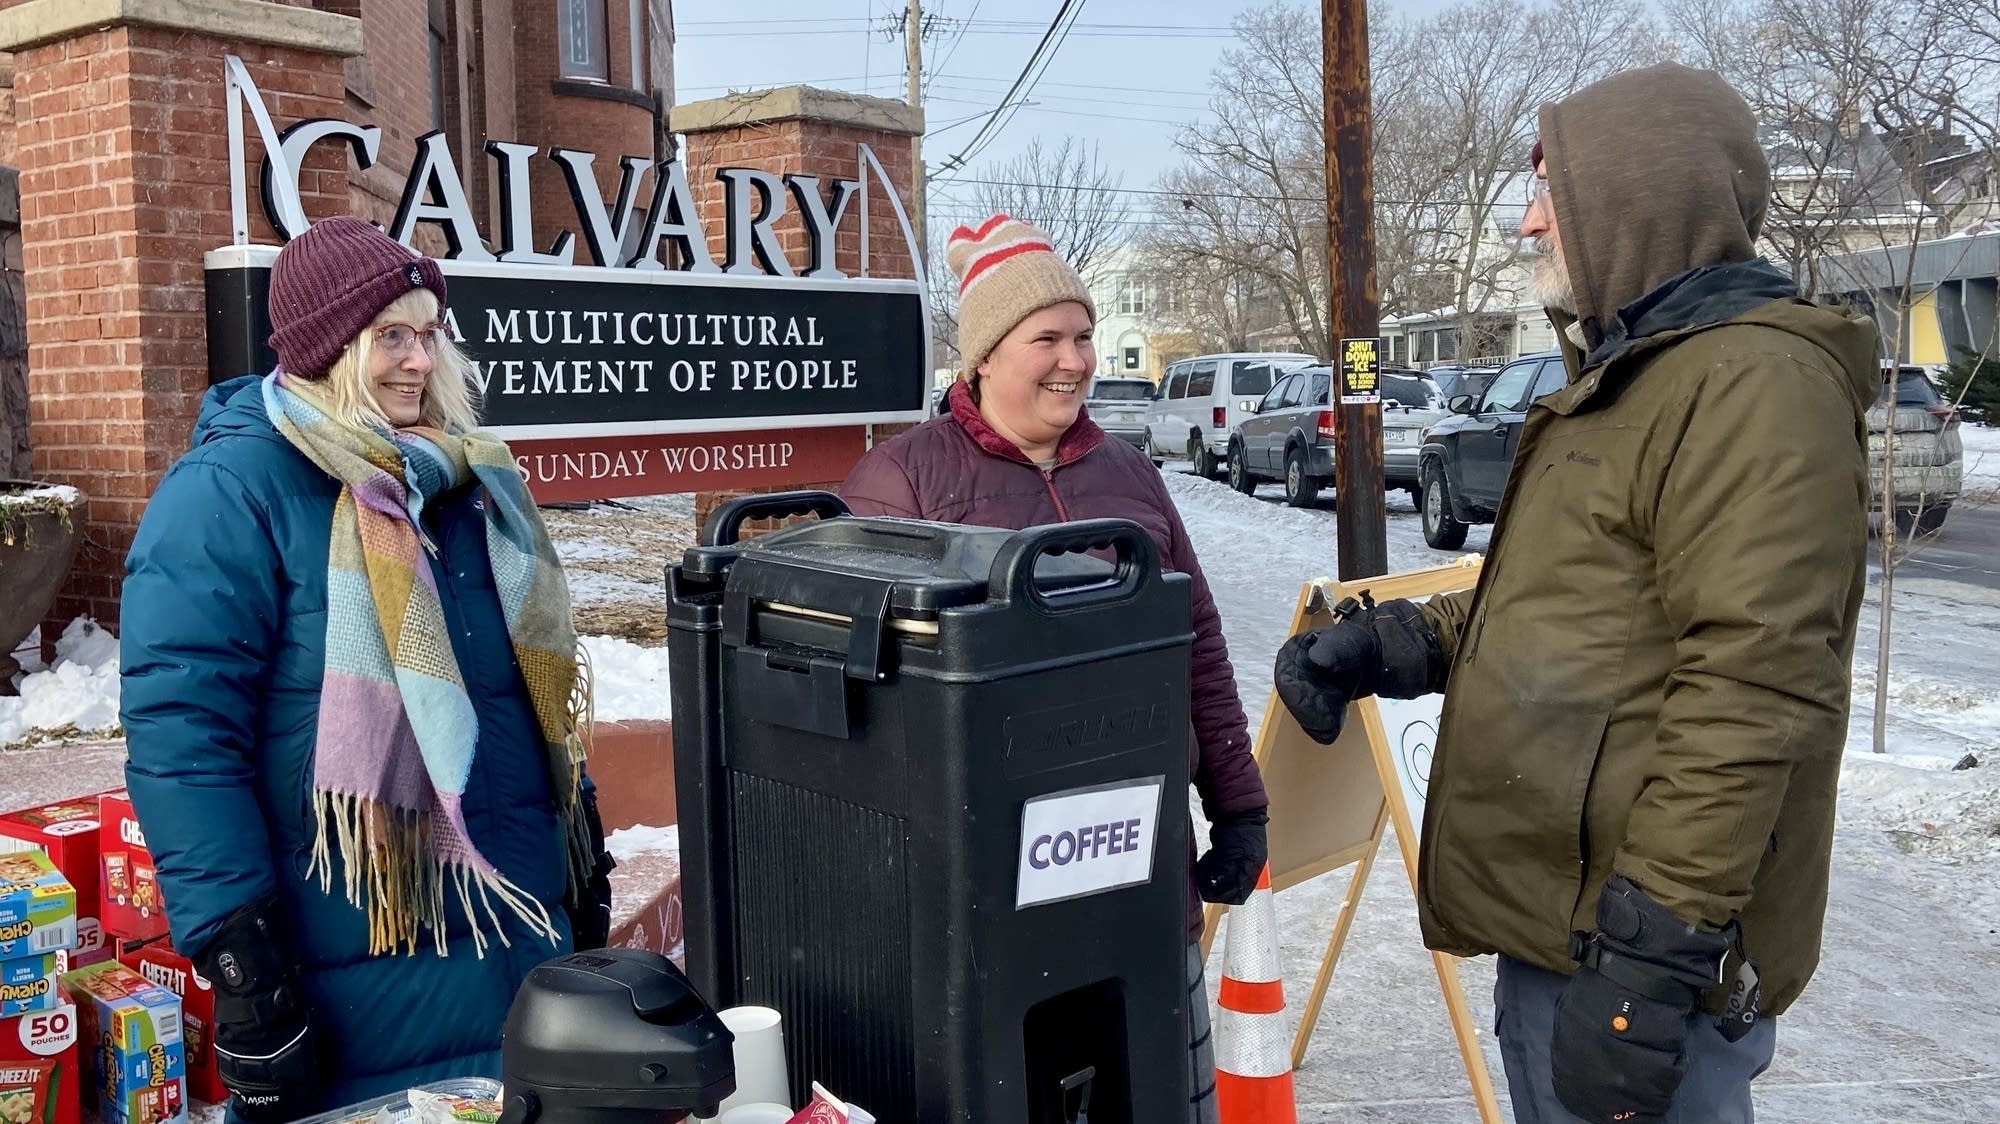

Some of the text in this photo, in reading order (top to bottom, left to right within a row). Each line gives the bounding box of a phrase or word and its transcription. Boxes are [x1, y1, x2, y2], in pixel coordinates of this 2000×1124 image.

[260, 117, 859, 278] CALVARY
[443, 308, 824, 345] A MULTICULTURAL
[1345, 351, 1376, 361] DOWN
[1349, 341, 1373, 351] SHUT
[469, 359, 858, 395] VEMENT OF PEOPLE
[1354, 362, 1369, 371] ICE
[516, 442, 794, 483] SUNDAY WORSHIP
[120, 817, 147, 847] CHE
[1028, 818, 1141, 870] COFFEE
[31, 1014, 69, 1038] 50
[31, 1034, 70, 1046] POUCHES
[0, 1069, 40, 1084] HEEZ-IT
